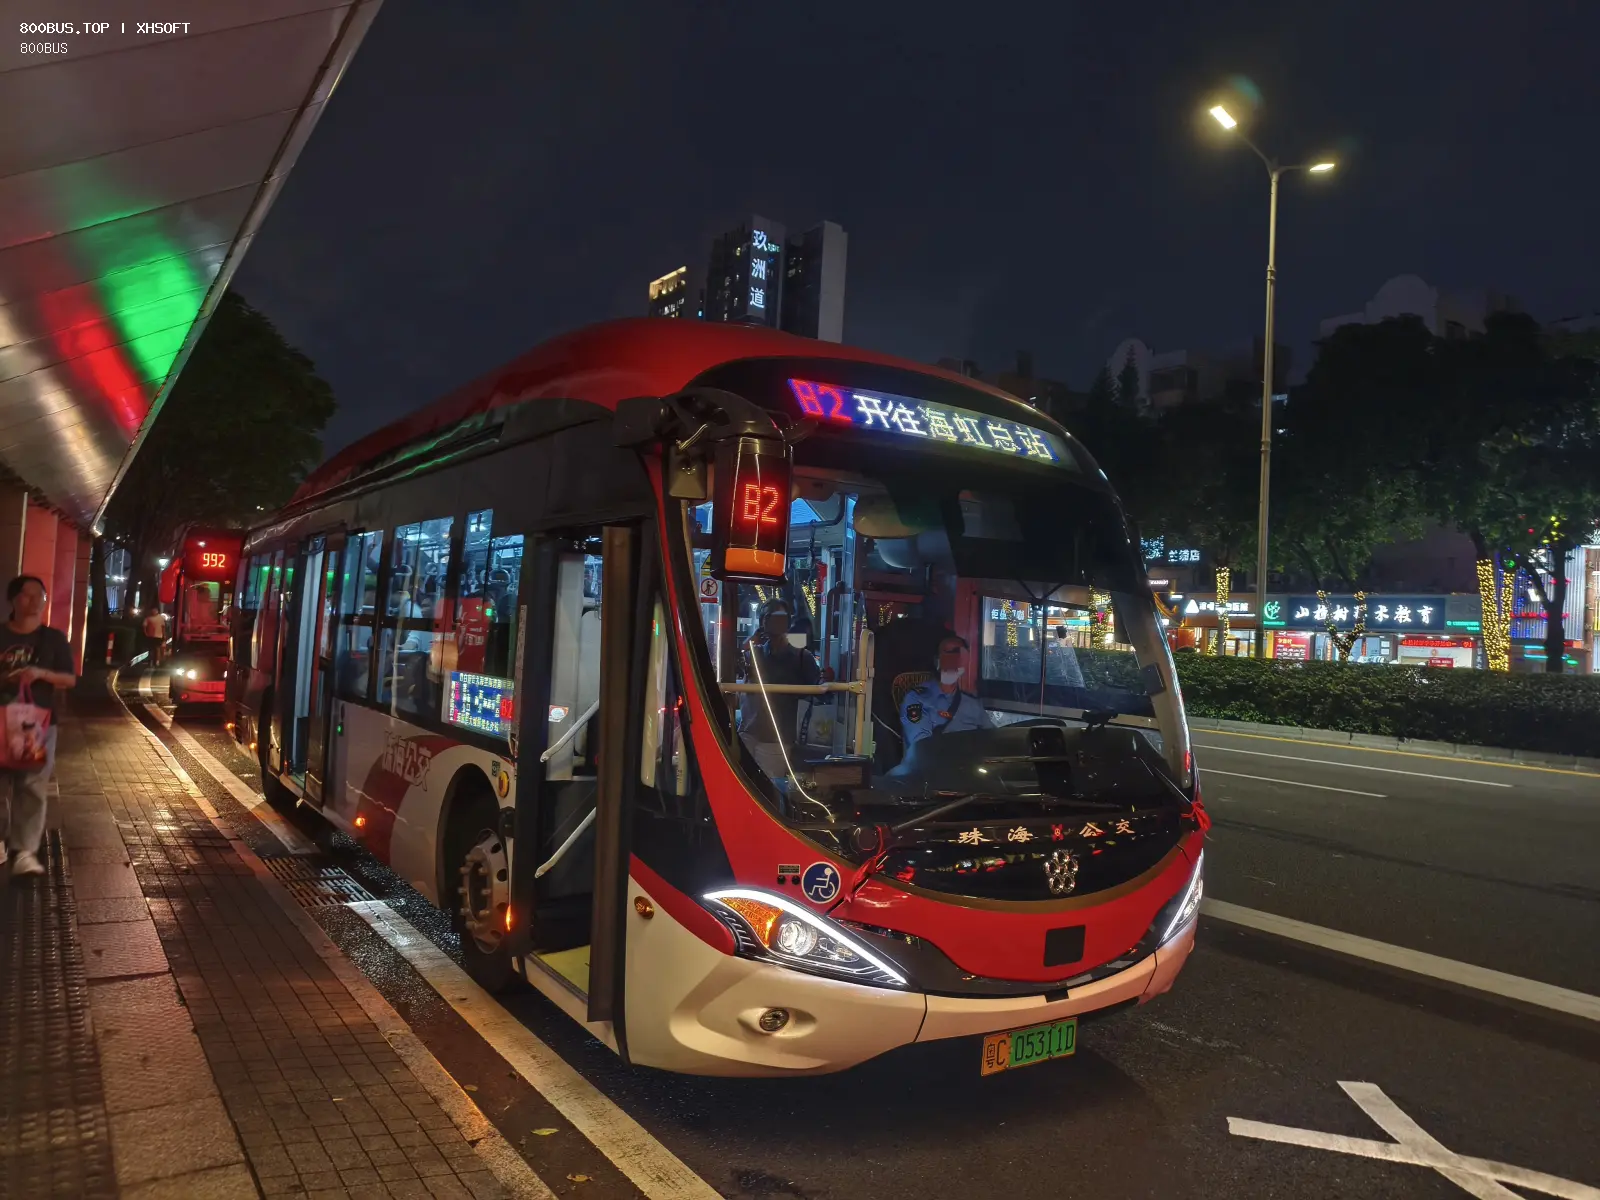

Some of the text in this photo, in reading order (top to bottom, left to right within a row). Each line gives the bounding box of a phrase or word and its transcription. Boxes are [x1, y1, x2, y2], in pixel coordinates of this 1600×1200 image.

[750, 229, 768, 309] 玖洲道
[787, 378, 853, 421] B2
[743, 483, 779, 523] B2
[202, 553, 226, 568] 992
